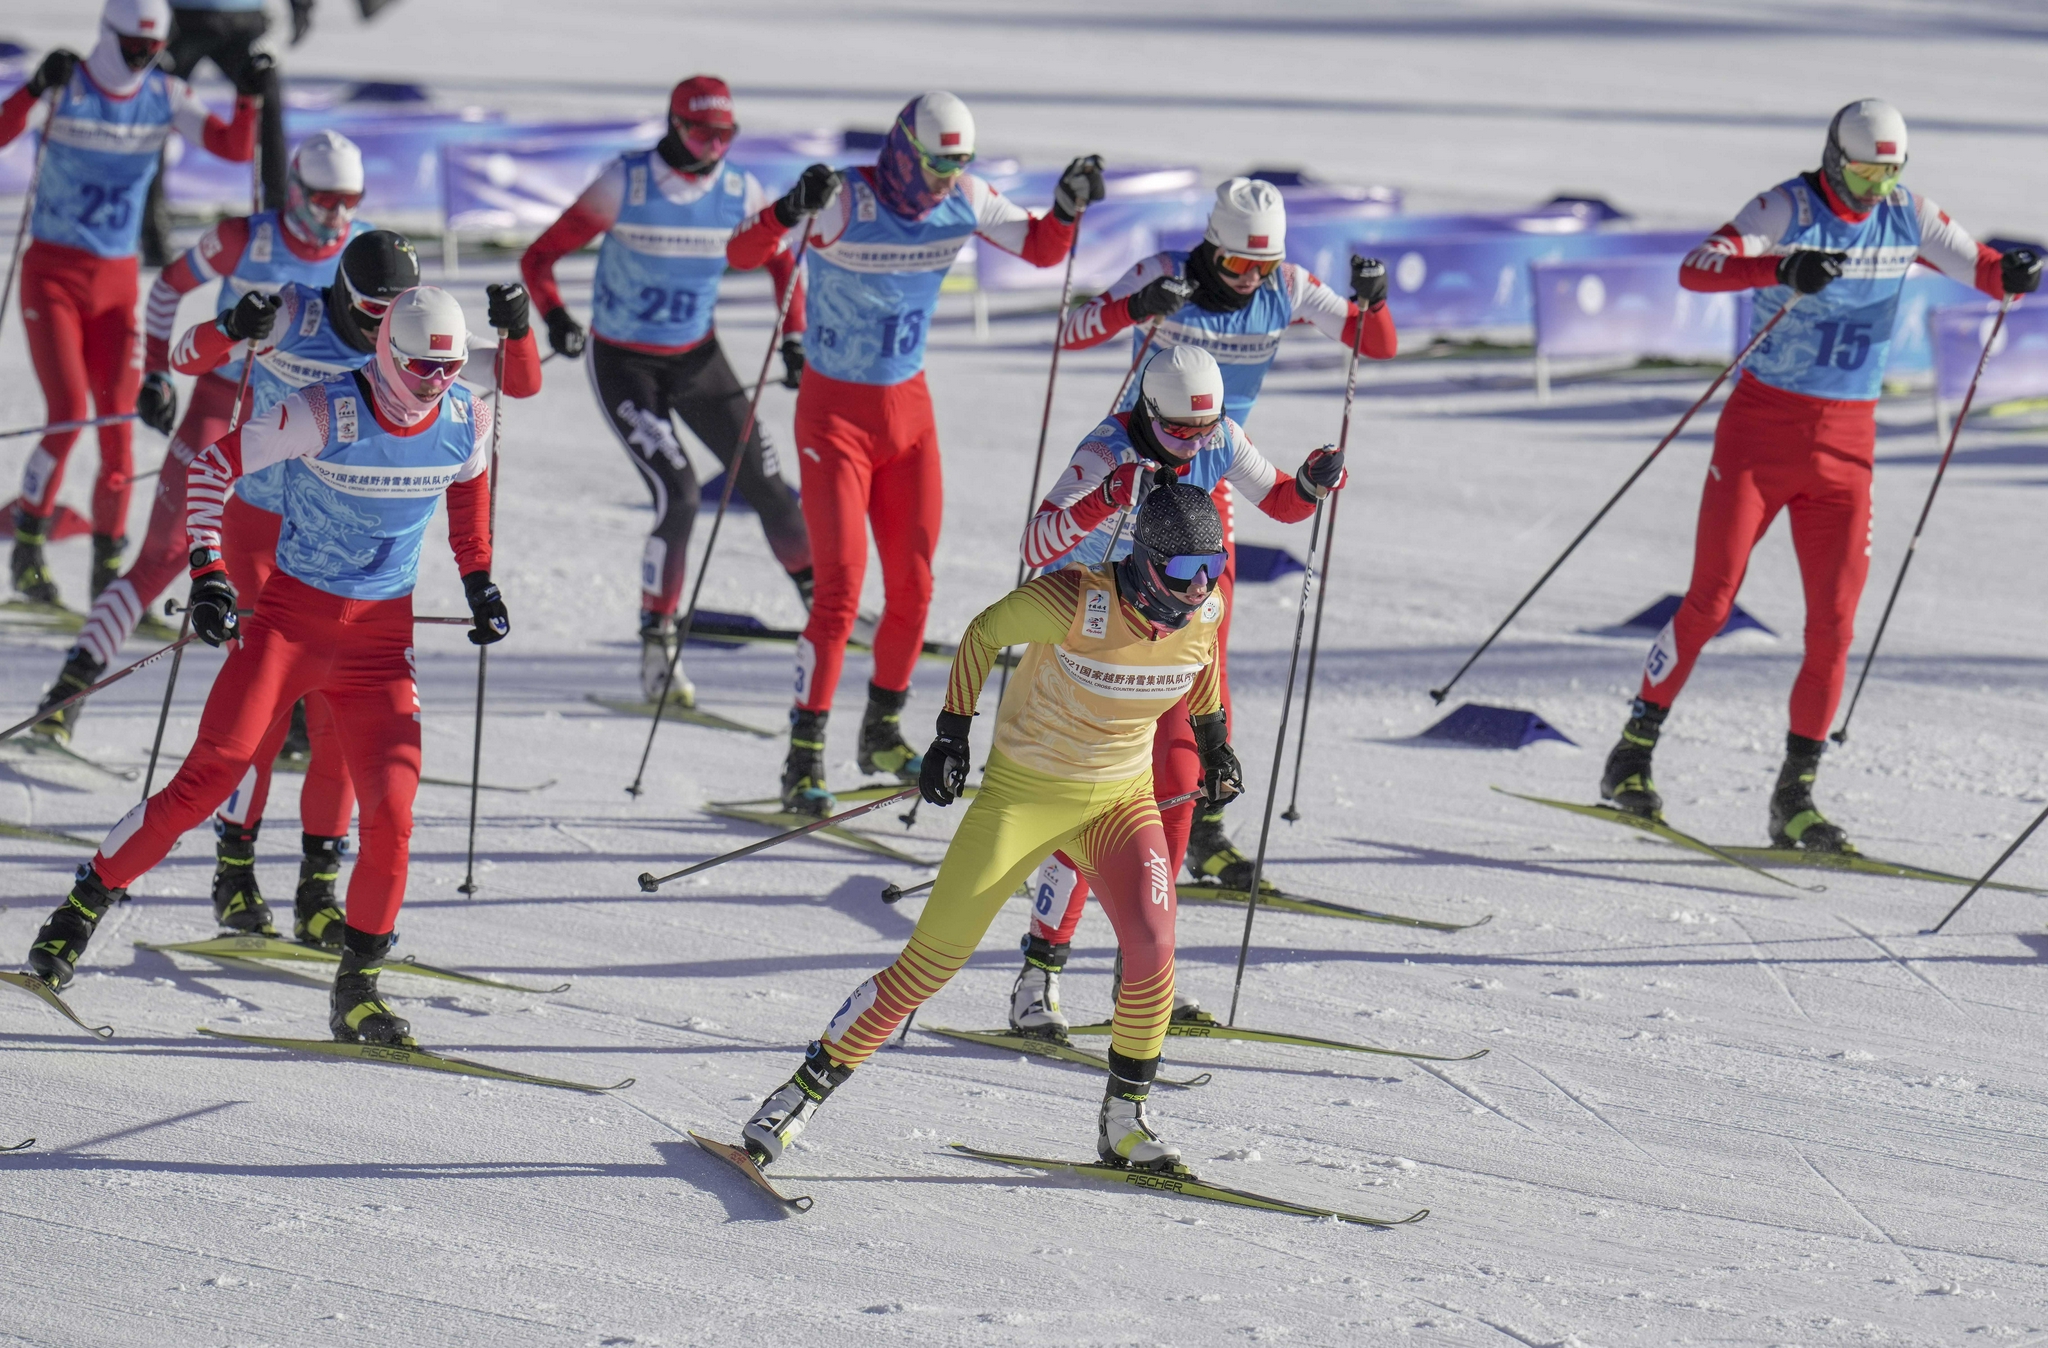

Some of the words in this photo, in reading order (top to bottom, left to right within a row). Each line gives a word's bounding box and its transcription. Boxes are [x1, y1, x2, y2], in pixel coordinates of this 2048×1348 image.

[78, 183, 132, 230] 25
[638, 286, 698, 325] 20
[816, 325, 838, 349] 13
[877, 309, 926, 358] 13
[1814, 319, 1873, 372] 15
[186, 443, 233, 554] CHINA
[1035, 883, 1055, 916] 6
[1165, 1026, 1211, 1038] SCHER
[360, 1046, 410, 1063] FISCHER
[1022, 1040, 1058, 1054] FISCHER
[1122, 1092, 1149, 1101] FISC
[1126, 1173, 1183, 1191] FISCHER
